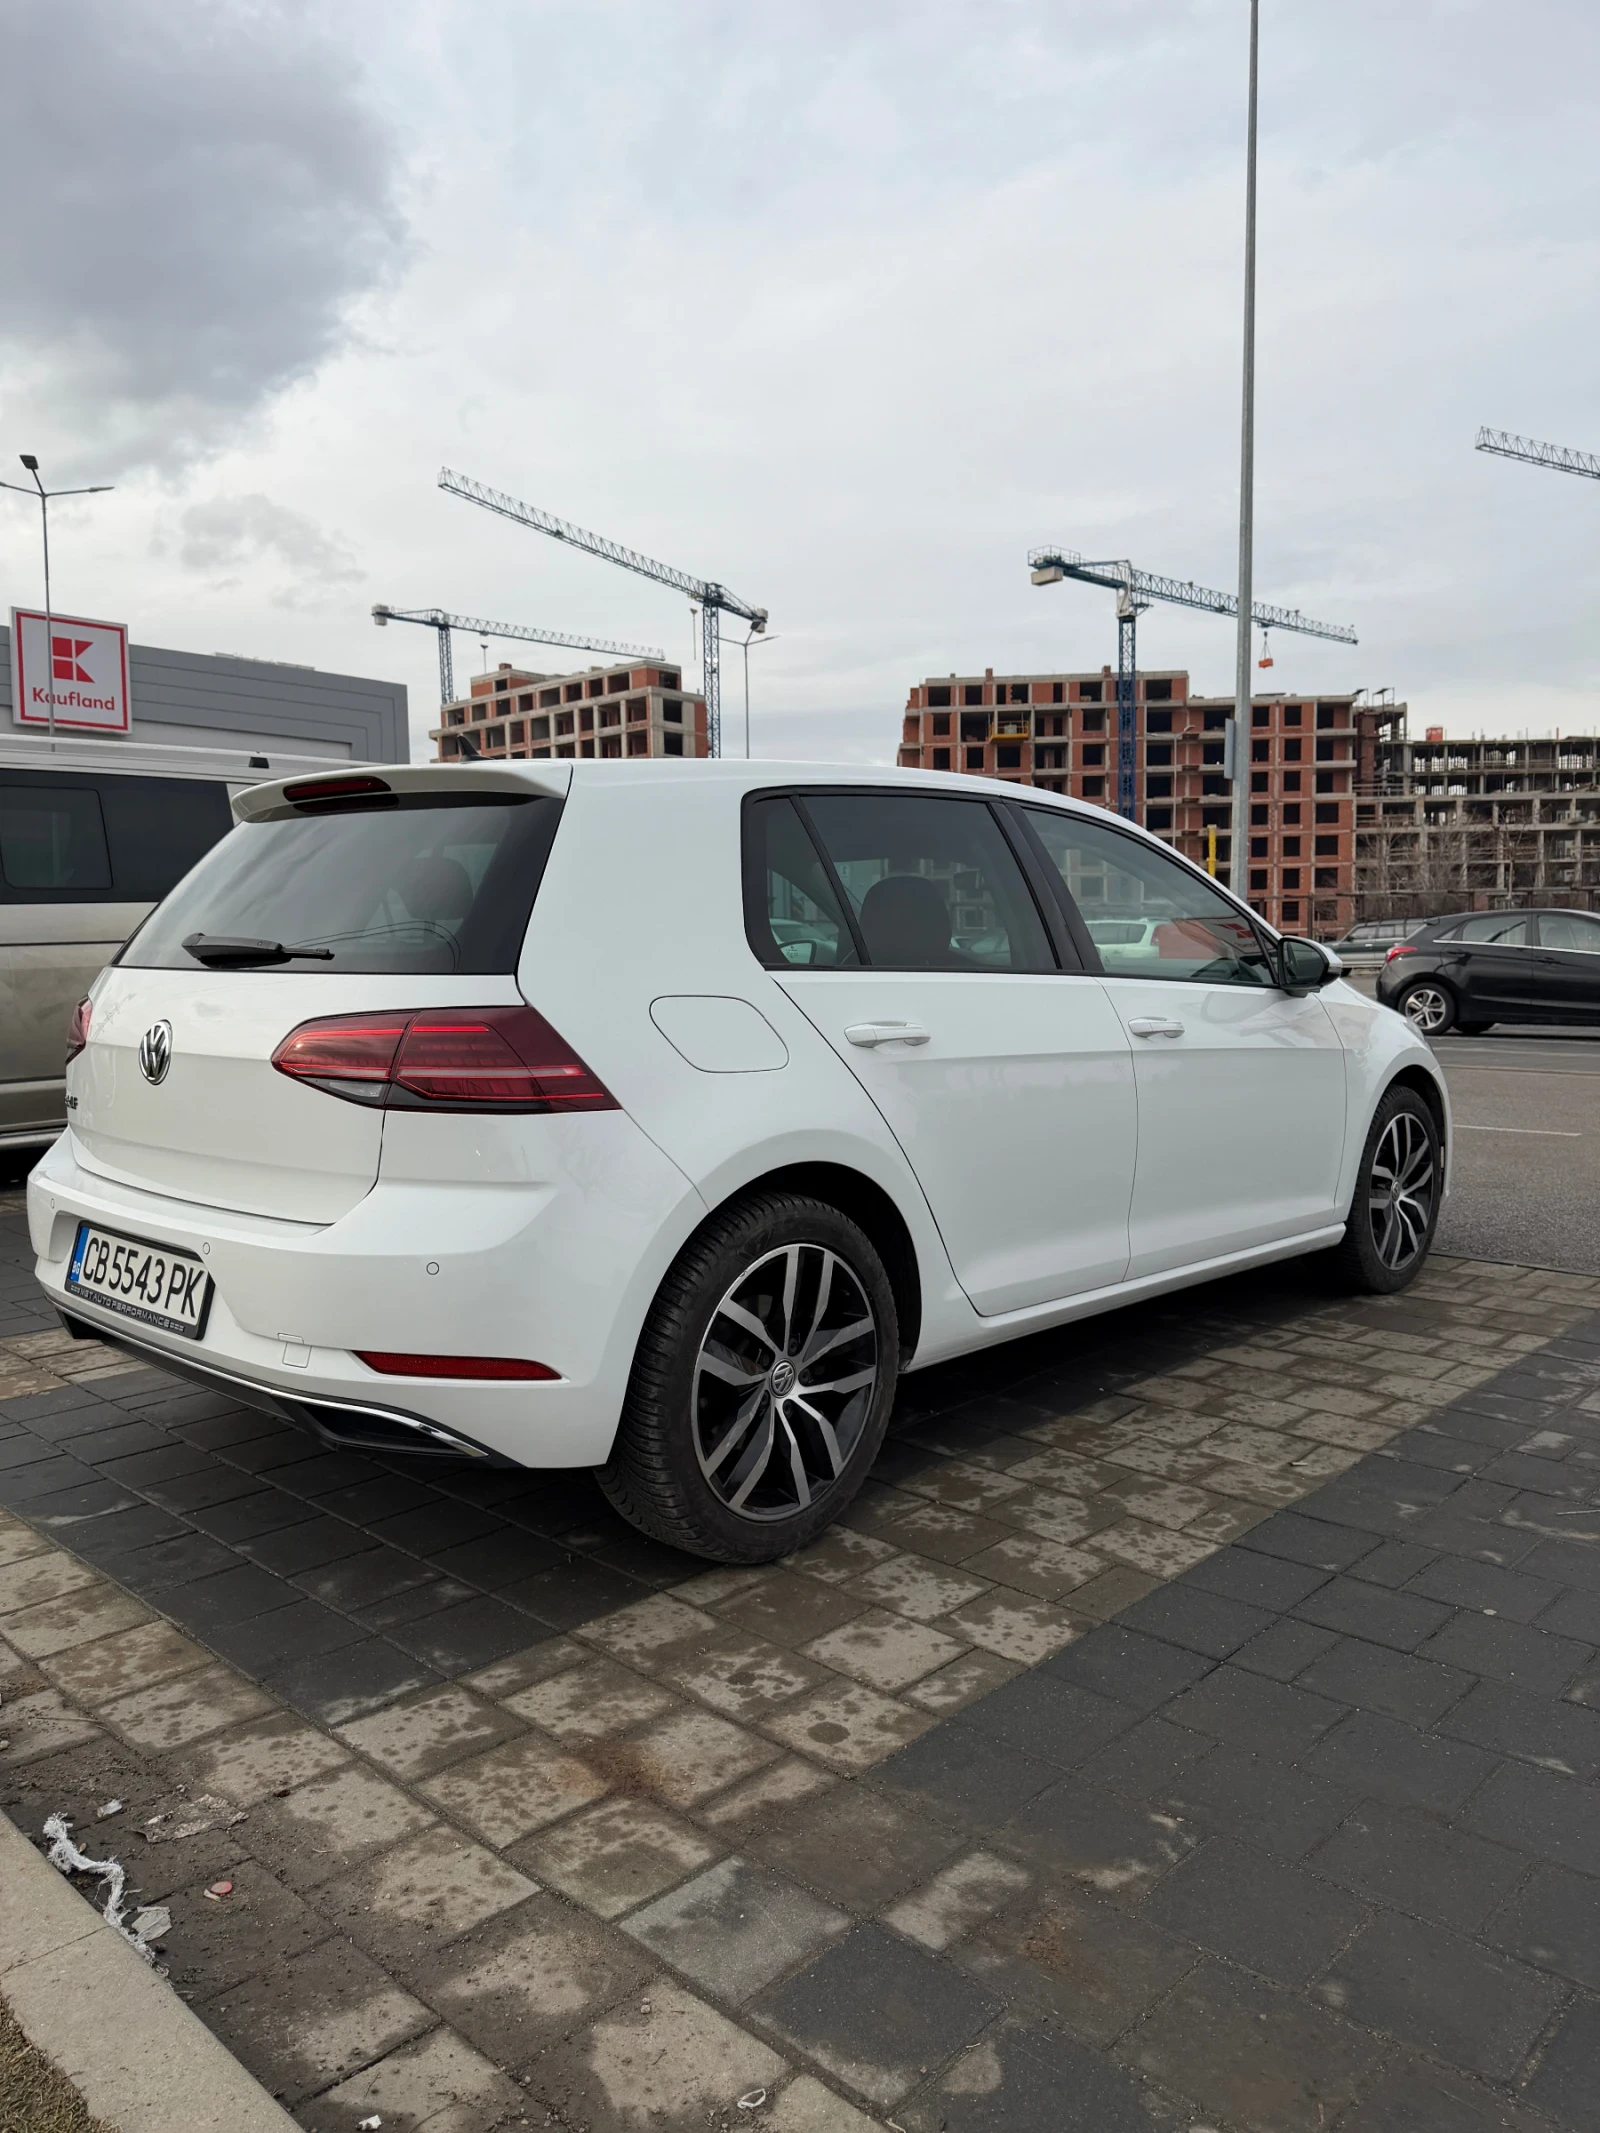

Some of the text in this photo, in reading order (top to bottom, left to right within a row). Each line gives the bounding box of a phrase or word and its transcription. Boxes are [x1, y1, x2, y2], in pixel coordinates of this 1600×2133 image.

[32, 687, 115, 711] Kaufland
[72, 1260, 81, 1275] BG
[83, 1237, 205, 1319] CB 5543 PK
[93, 1293, 111, 1306] AUTO
[111, 1300, 170, 1328] PERFORMANCE
